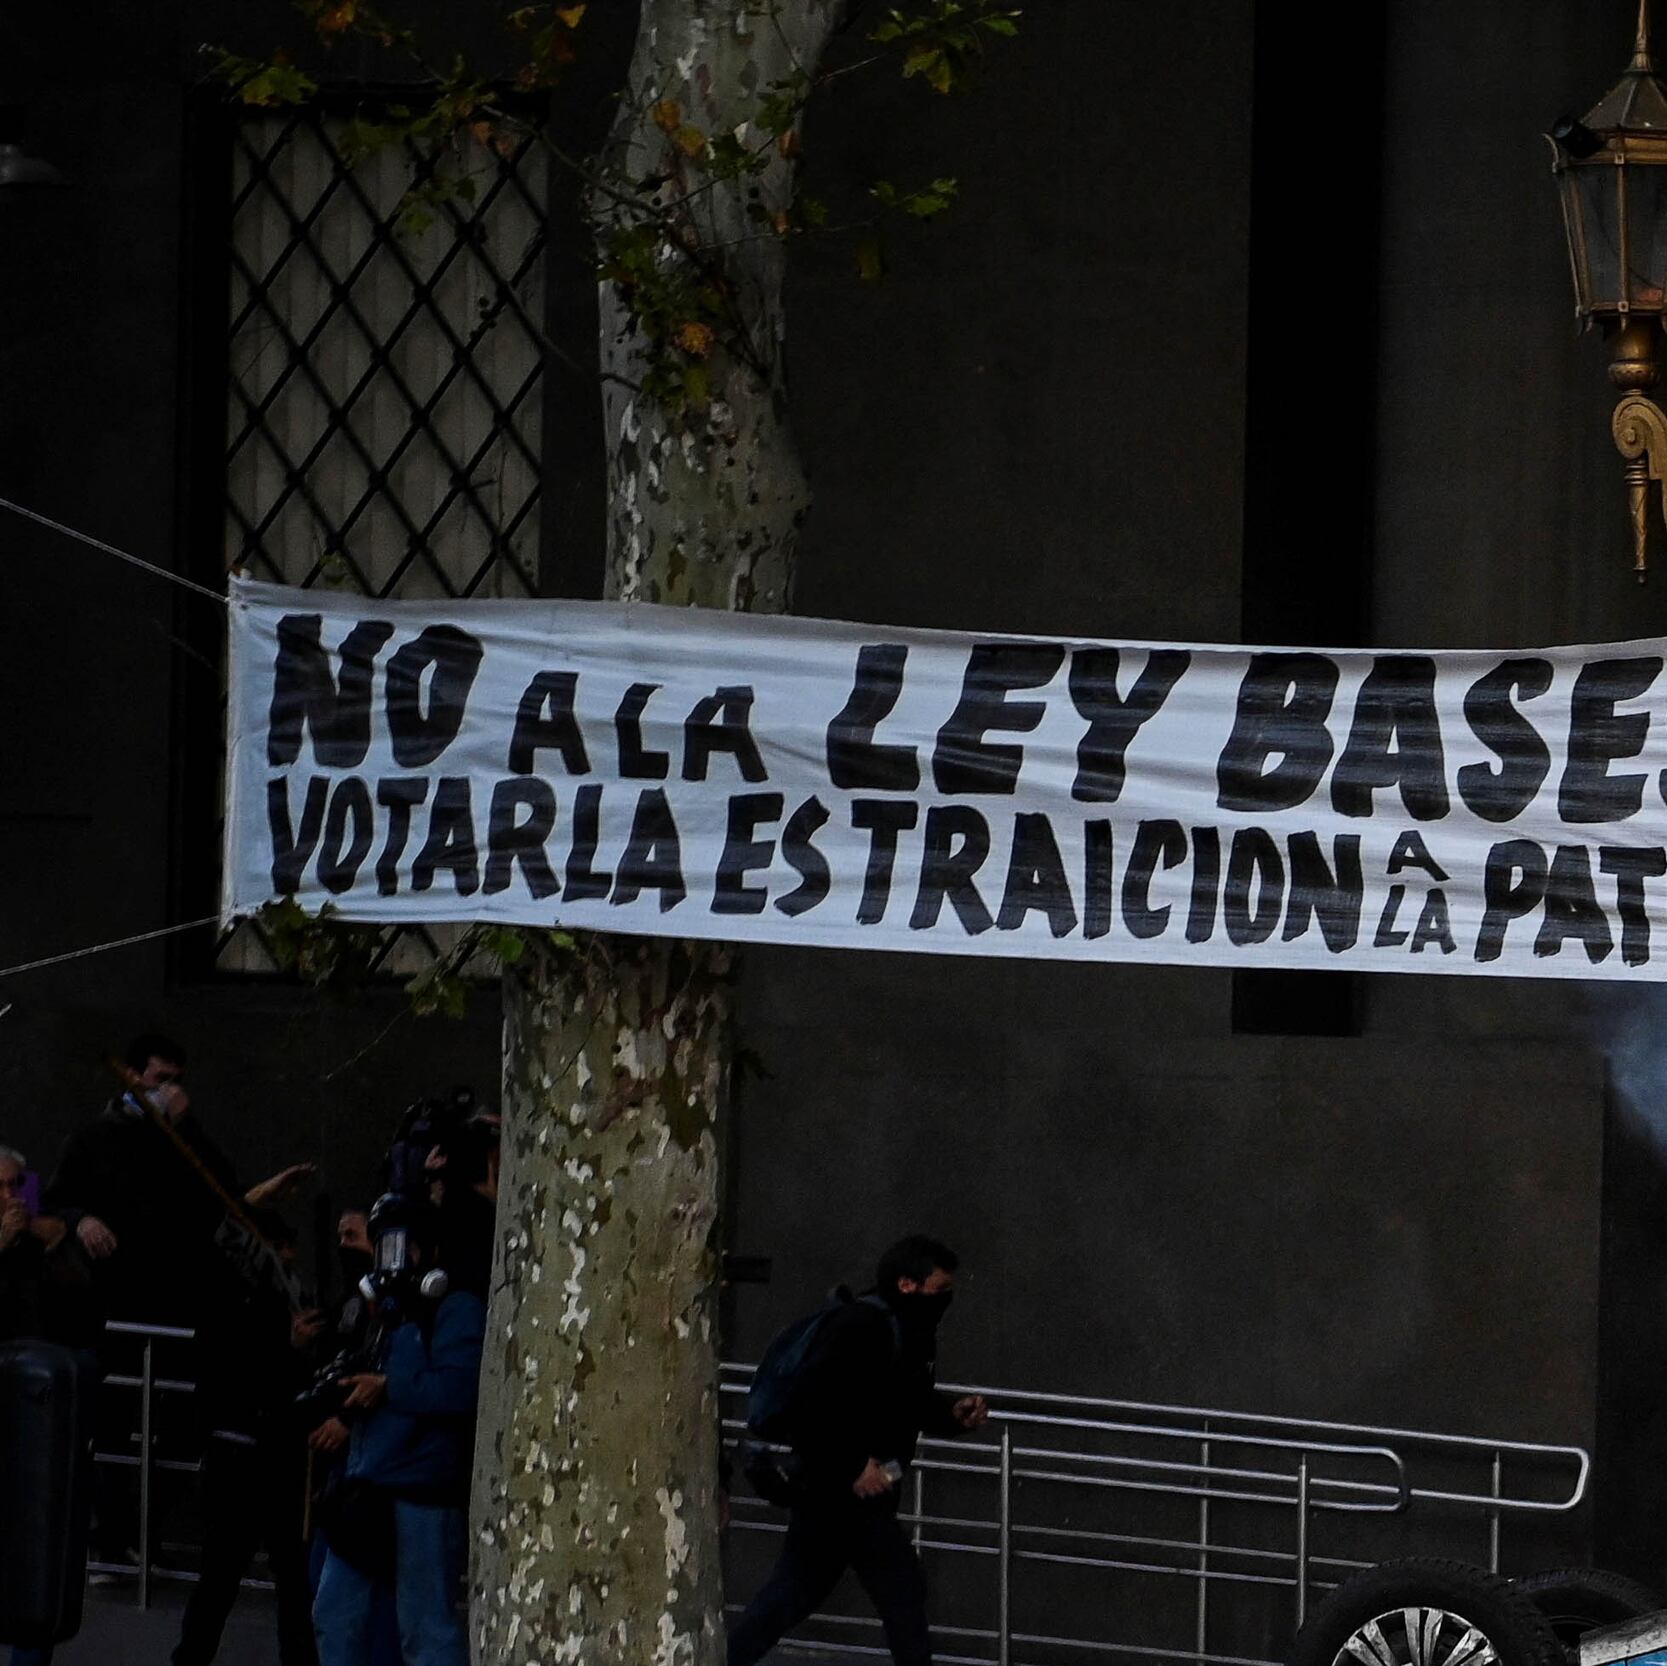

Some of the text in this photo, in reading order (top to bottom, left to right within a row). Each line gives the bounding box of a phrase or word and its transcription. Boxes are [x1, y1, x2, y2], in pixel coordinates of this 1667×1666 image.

[267, 613, 485, 769] NO
[508, 671, 592, 775] A
[614, 682, 769, 783] LA
[826, 640, 1192, 803] LEY
[266, 774, 687, 914] VOTARLA
[711, 792, 831, 918] ES
[850, 798, 1363, 953] TRAICION
[1387, 830, 1449, 881] A
[1373, 884, 1457, 954] LA
